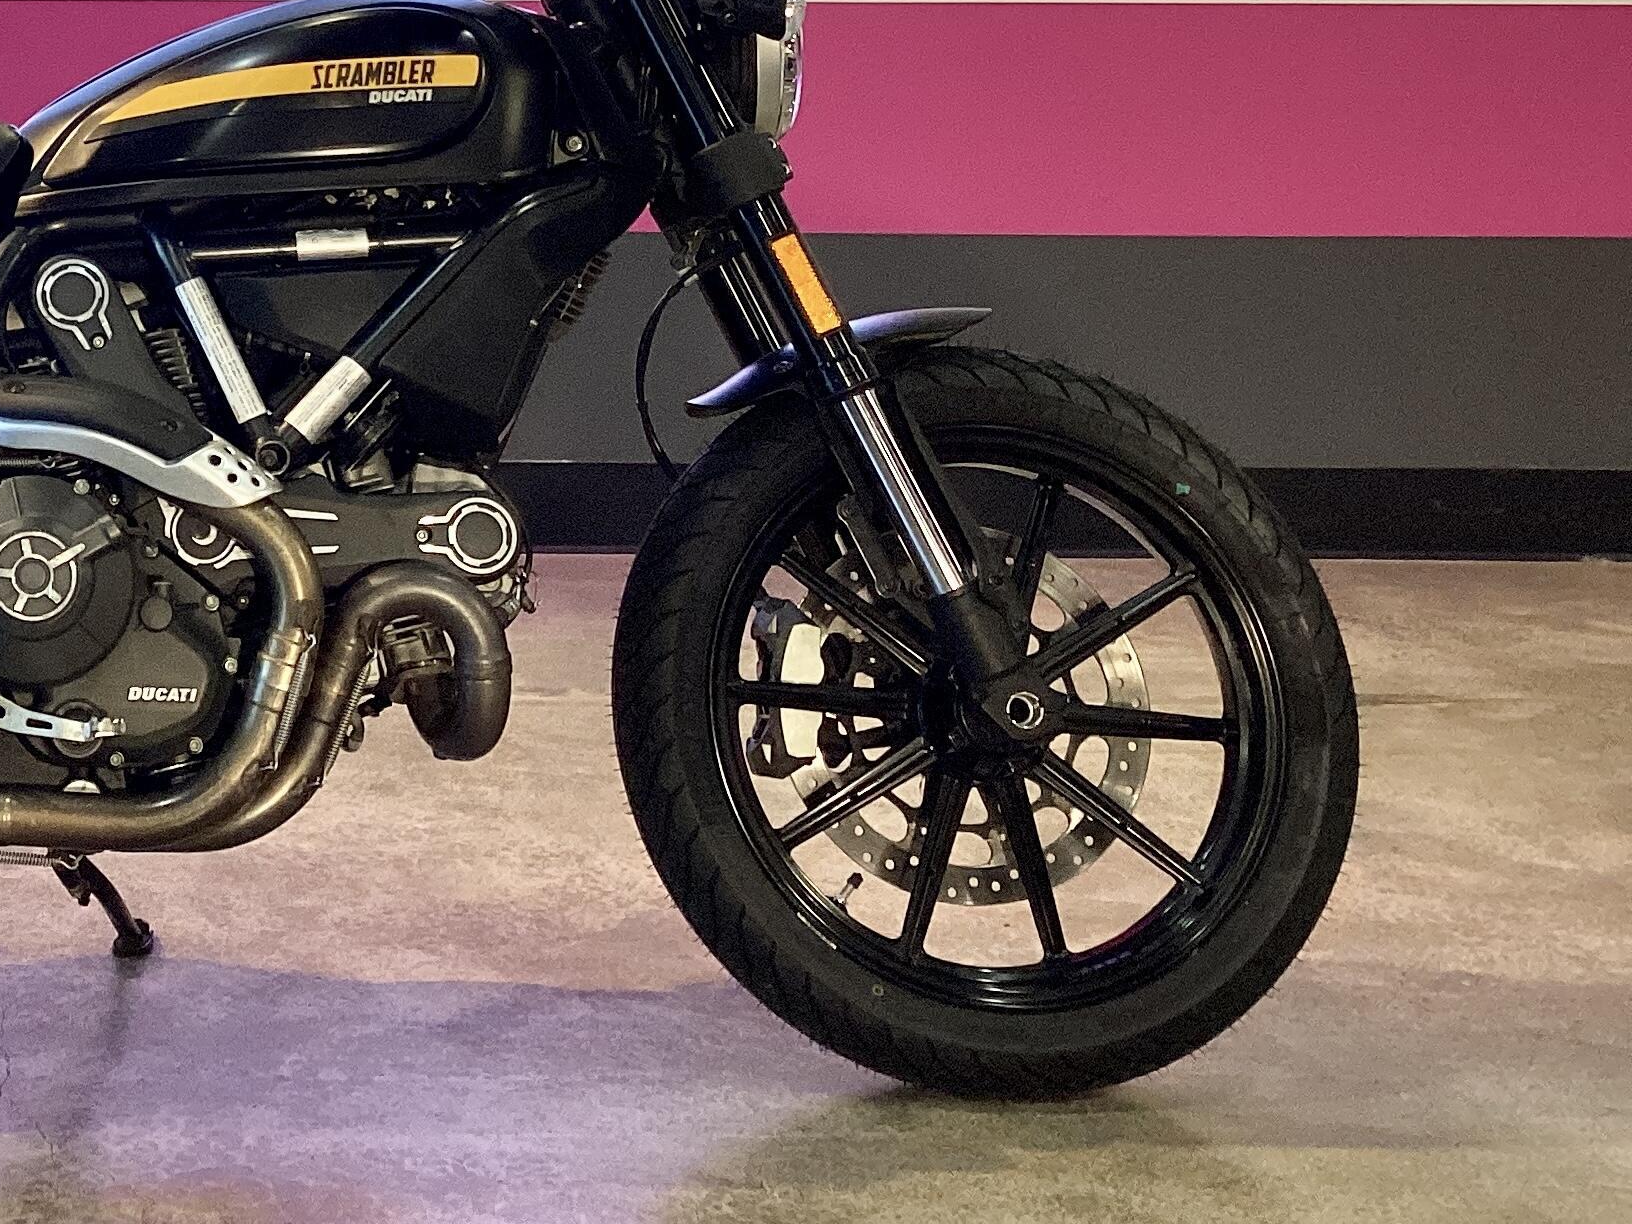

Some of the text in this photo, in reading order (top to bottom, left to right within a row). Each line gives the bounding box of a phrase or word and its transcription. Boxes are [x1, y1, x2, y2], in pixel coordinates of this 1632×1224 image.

[310, 59, 435, 89] SCRAMBLER
[369, 89, 433, 104] DUCATI
[128, 686, 198, 703] DUCATI
